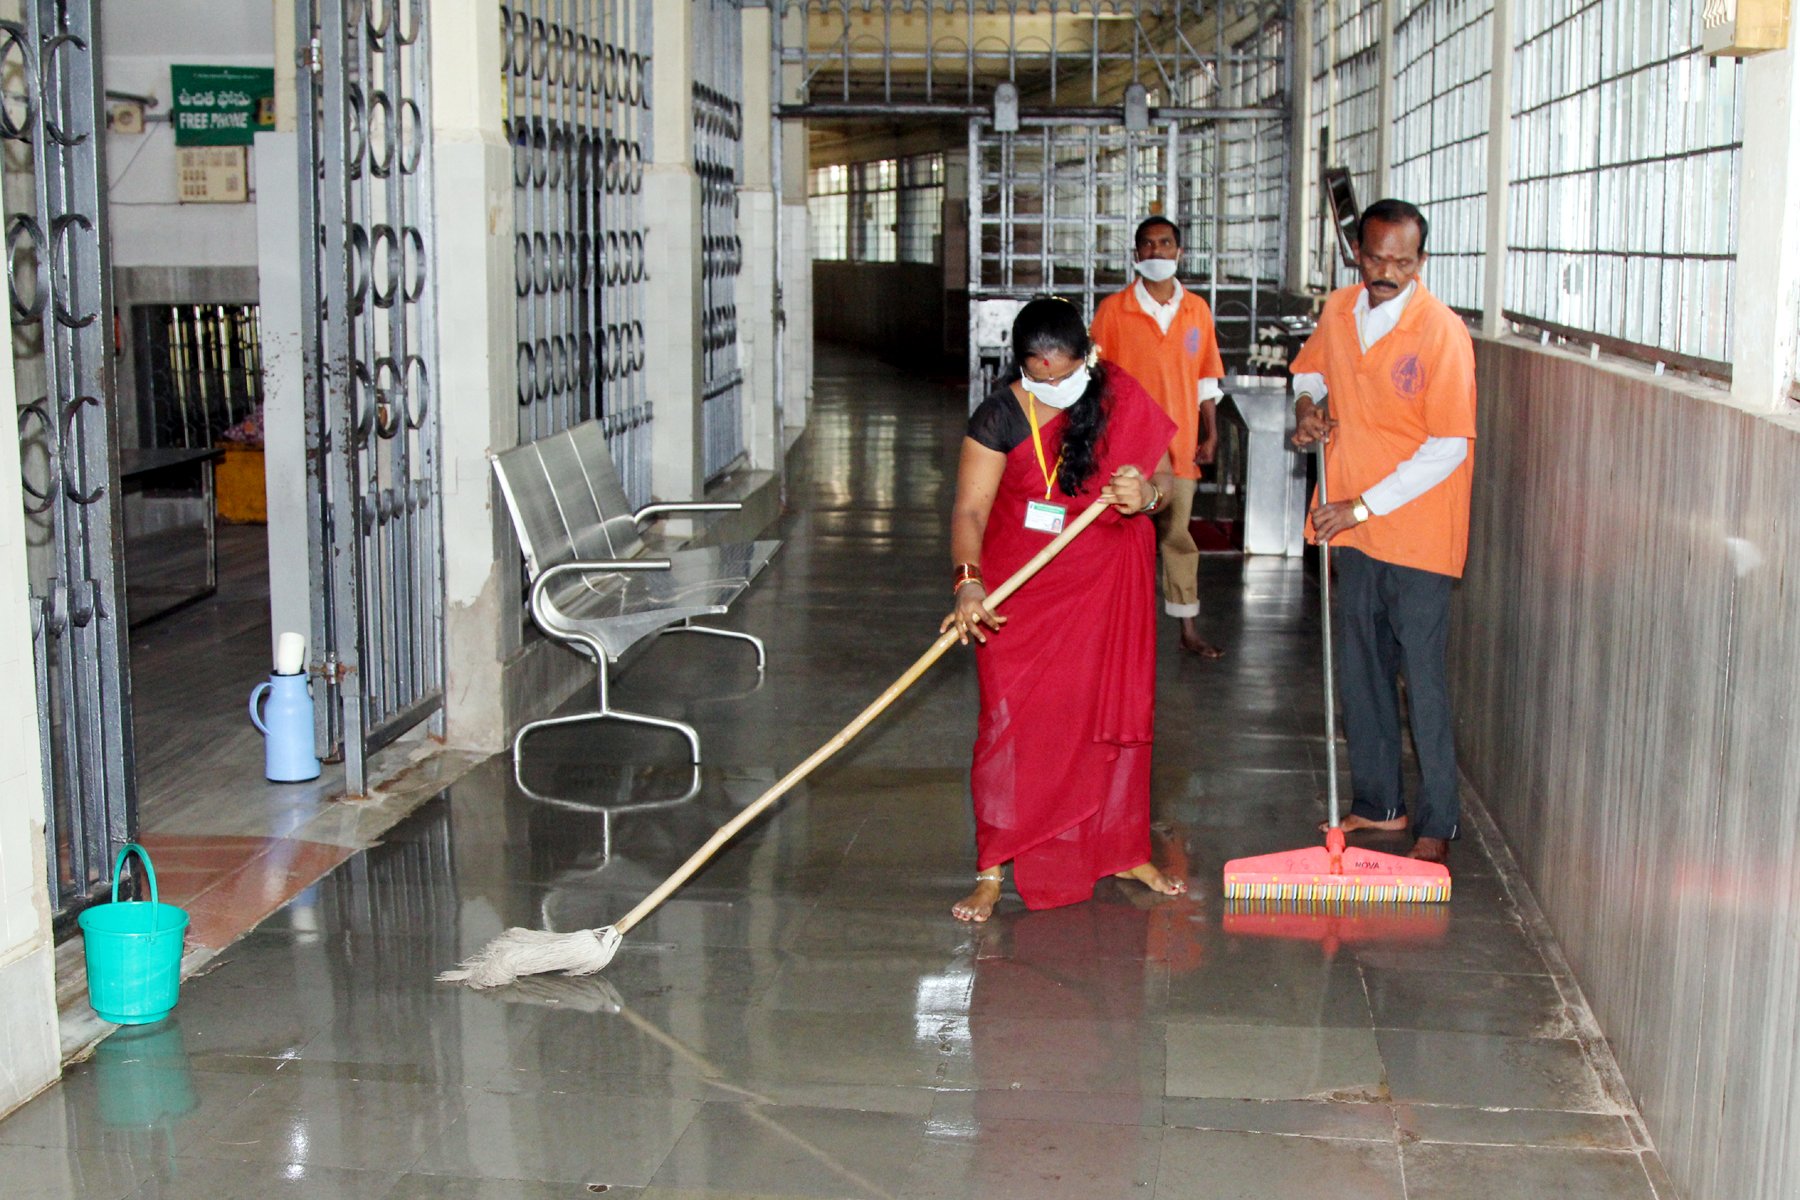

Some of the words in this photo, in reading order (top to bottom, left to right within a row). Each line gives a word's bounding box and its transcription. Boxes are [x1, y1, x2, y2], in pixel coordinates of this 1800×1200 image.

[179, 88, 215, 107] ఉచిత
[179, 112, 208, 129] FREE
[210, 112, 249, 129] PHONE
[1355, 861, 1380, 870] NOVA
